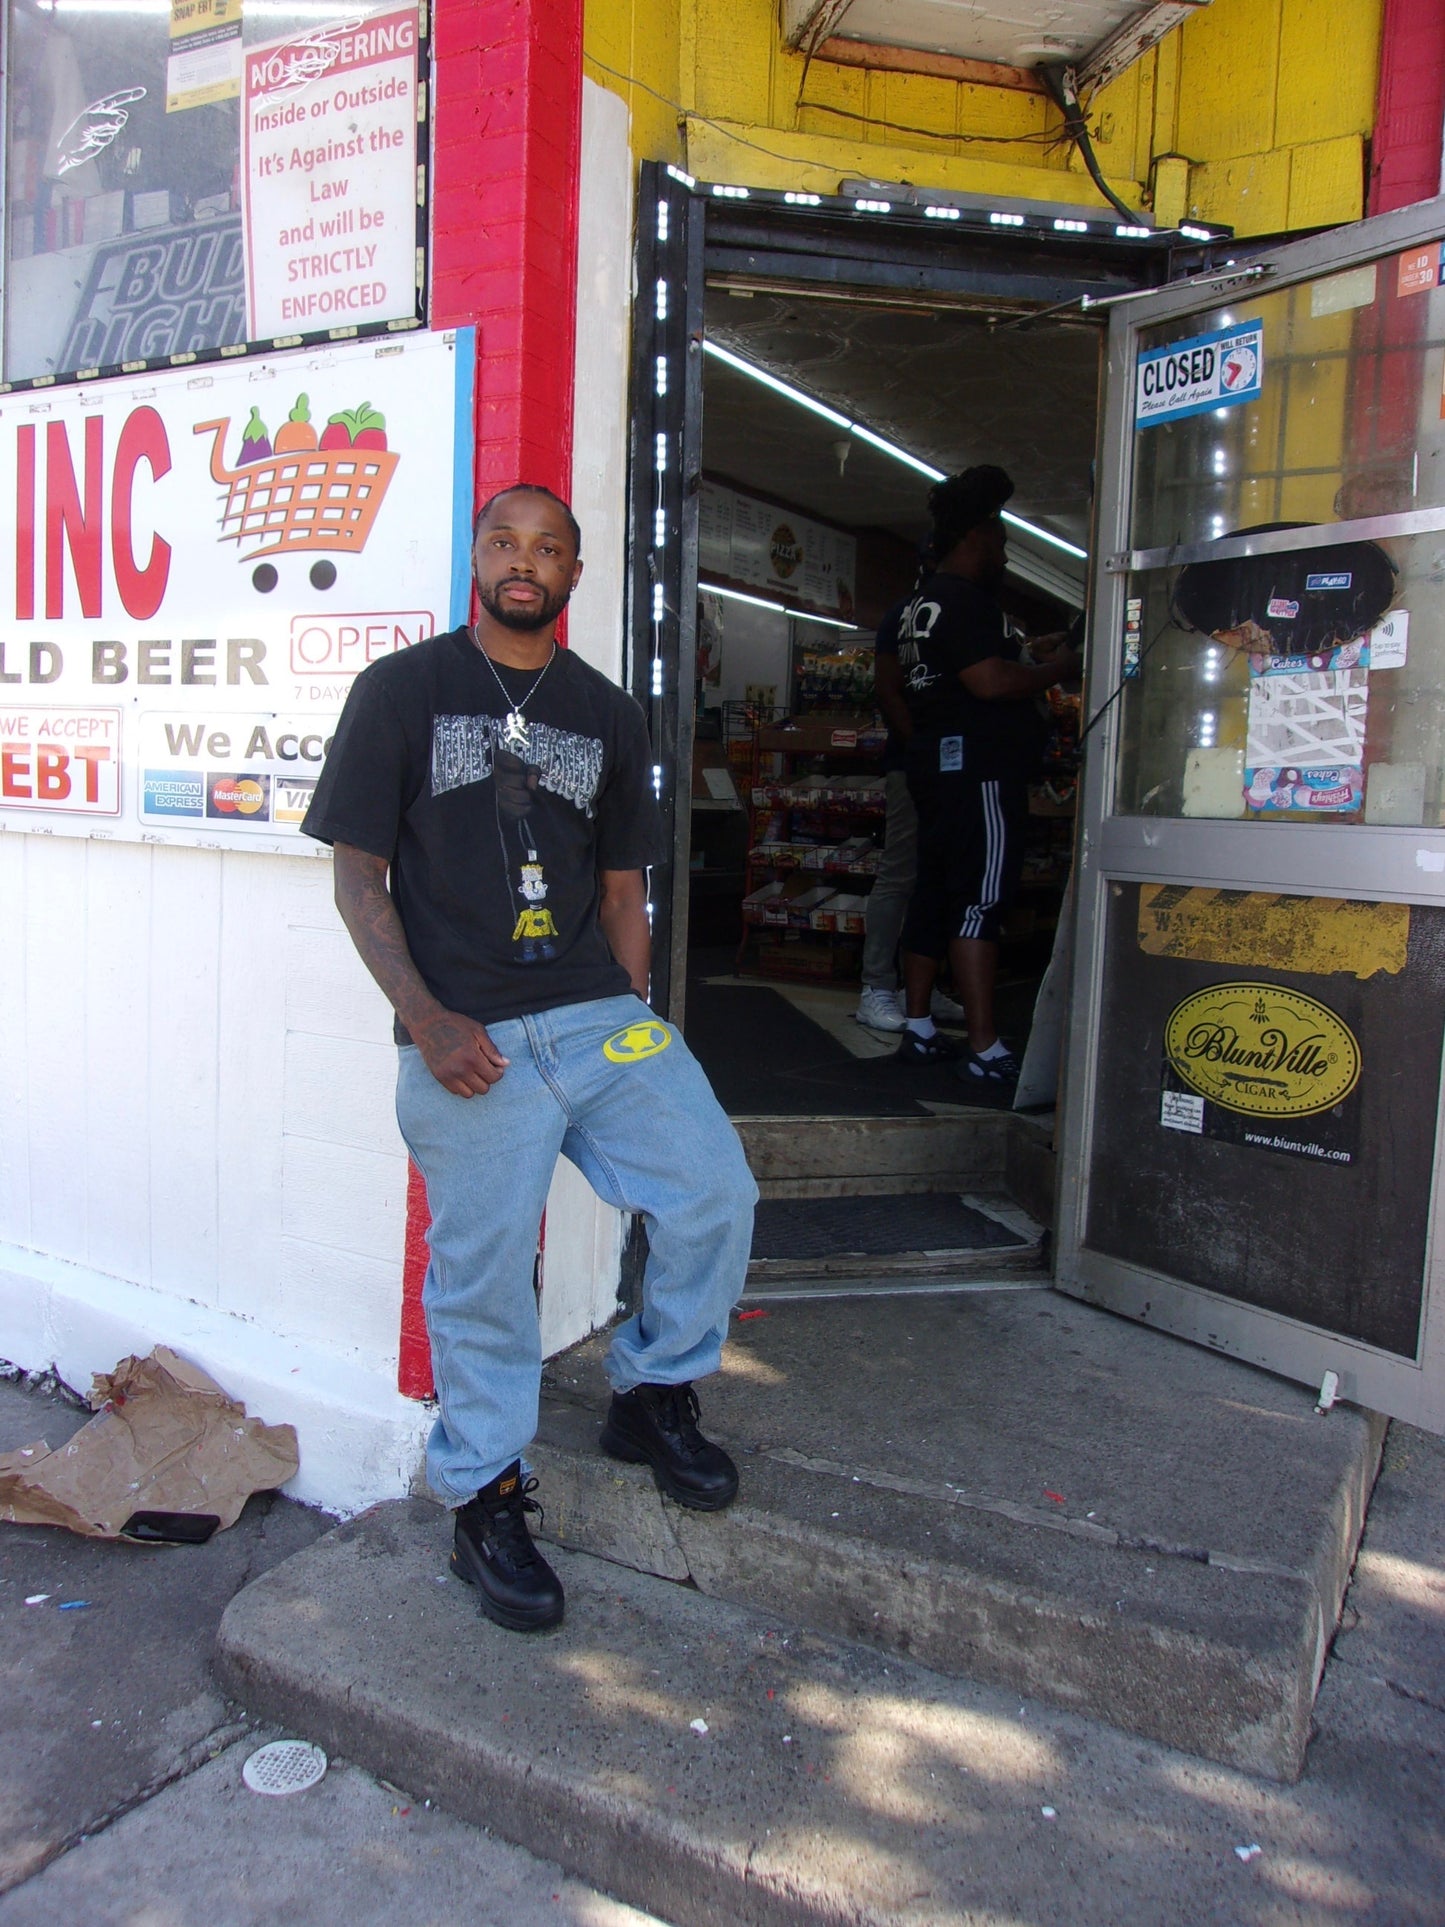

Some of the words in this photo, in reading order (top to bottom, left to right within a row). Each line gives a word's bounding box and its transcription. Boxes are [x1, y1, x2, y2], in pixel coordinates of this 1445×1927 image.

[175, 3, 196, 20] SNAP
[252, 56, 284, 88] NO
[255, 102, 306, 132] Inside
[311, 99, 329, 118] or
[334, 77, 408, 111] Outside
[259, 153, 285, 177] It's
[290, 130, 364, 172] Against
[370, 126, 404, 150] the
[311, 179, 348, 202] Law
[279, 218, 314, 246] and
[320, 209, 353, 238] will
[360, 207, 384, 230] be
[110, 227, 245, 310] BUD
[288, 244, 377, 282] STRICTLY
[1419, 268, 1433, 285] 30
[282, 282, 387, 320] ENFORCED
[1220, 340, 1233, 350] WILL
[1235, 333, 1258, 347] RETURN
[1144, 347, 1215, 396] CLOSED
[1141, 400, 1166, 412] Please
[1168, 391, 1186, 406] Call
[1188, 388, 1213, 401] Again
[16, 405, 172, 620] INC
[298, 624, 424, 664] OPEN
[92, 638, 269, 685] BEER
[1271, 657, 1303, 670] Cakes
[294, 686, 302, 700] 7
[0, 716, 29, 736] WE
[38, 718, 114, 738] ACCEPT
[164, 723, 231, 759] We
[2, 742, 110, 803] EBT
[1307, 769, 1340, 782] Cakes
[145, 782, 200, 795] AMERICAN
[156, 796, 204, 808] EXPRESS
[214, 790, 263, 802] MasterCard
[1235, 1081, 1278, 1099] CIGAR
